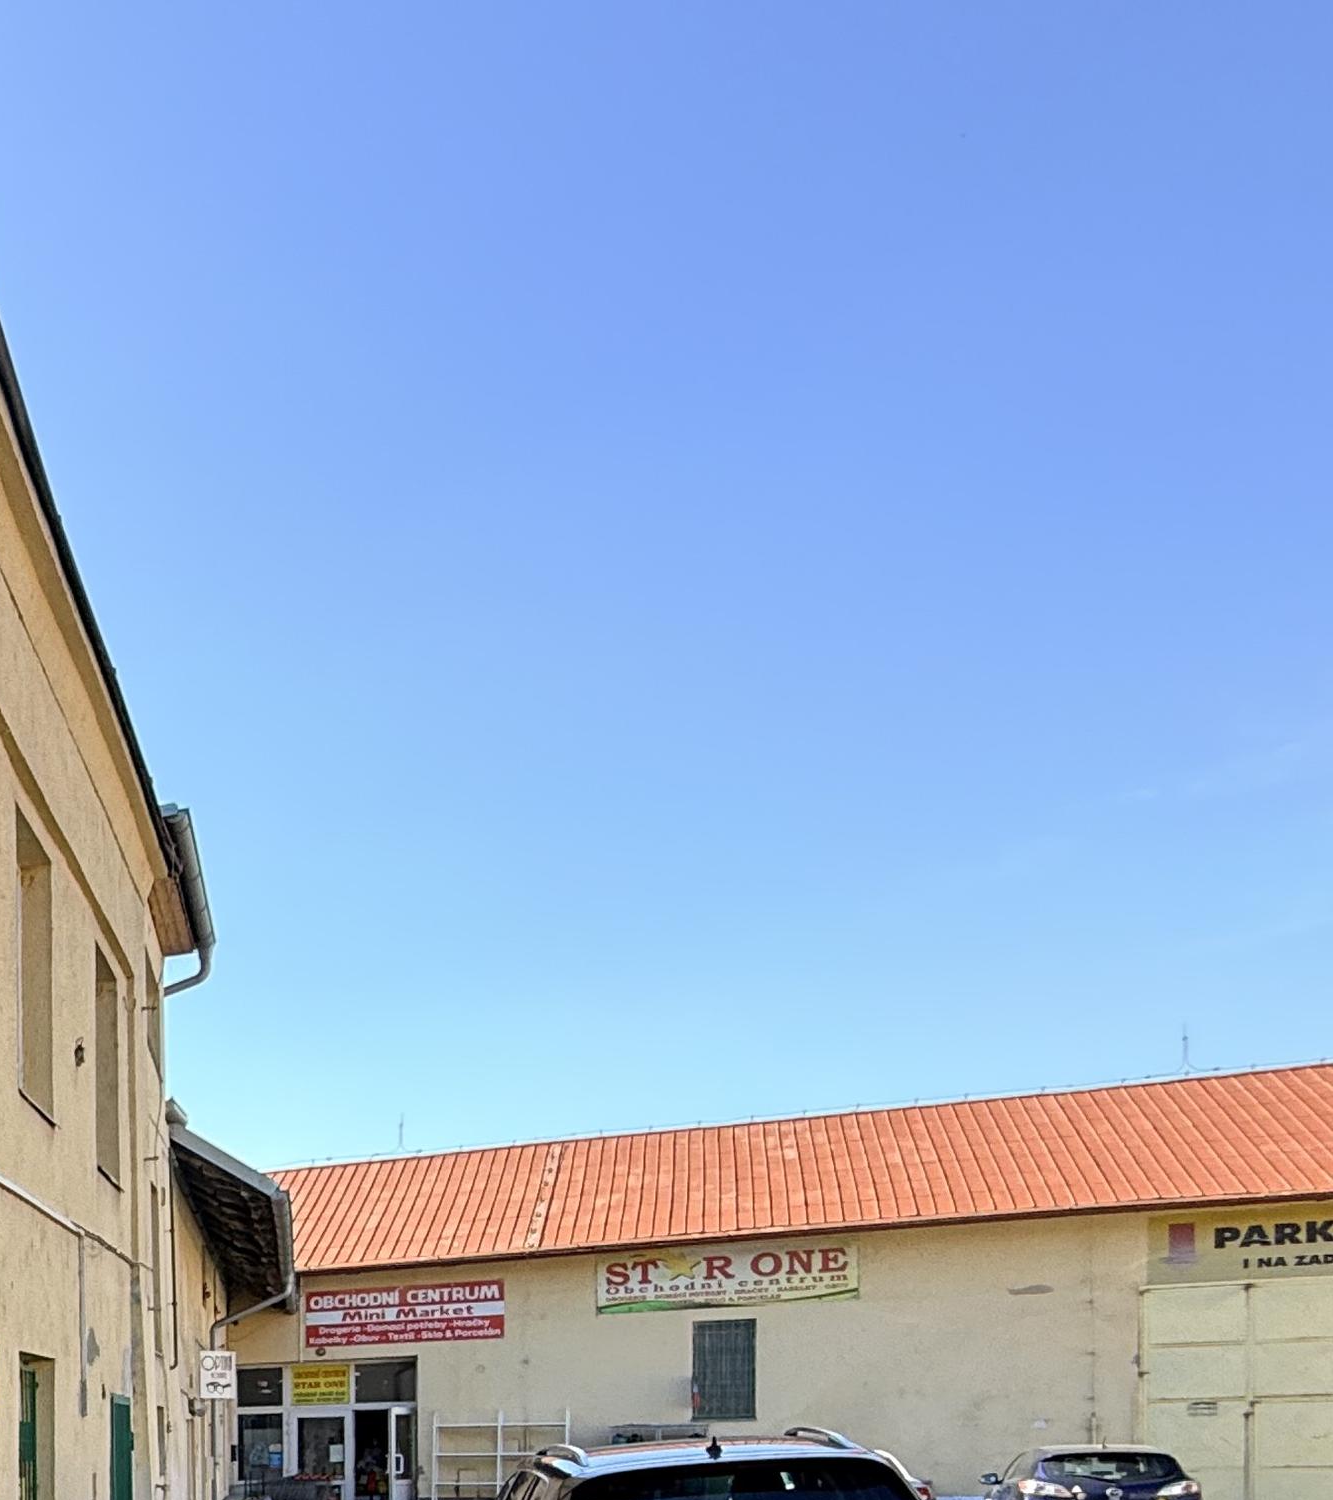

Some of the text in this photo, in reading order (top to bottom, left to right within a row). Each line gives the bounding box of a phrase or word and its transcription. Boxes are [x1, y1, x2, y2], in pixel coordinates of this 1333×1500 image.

[750, 1247, 849, 1277] ONE
[1243, 1258, 1249, 1269] I
[1257, 1256, 1287, 1268] NA
[738, 1274, 849, 1287] centrum
[309, 1284, 500, 1310] OBCHODNÍ CENTRUM
[341, 1305, 474, 1322] Mini Market
